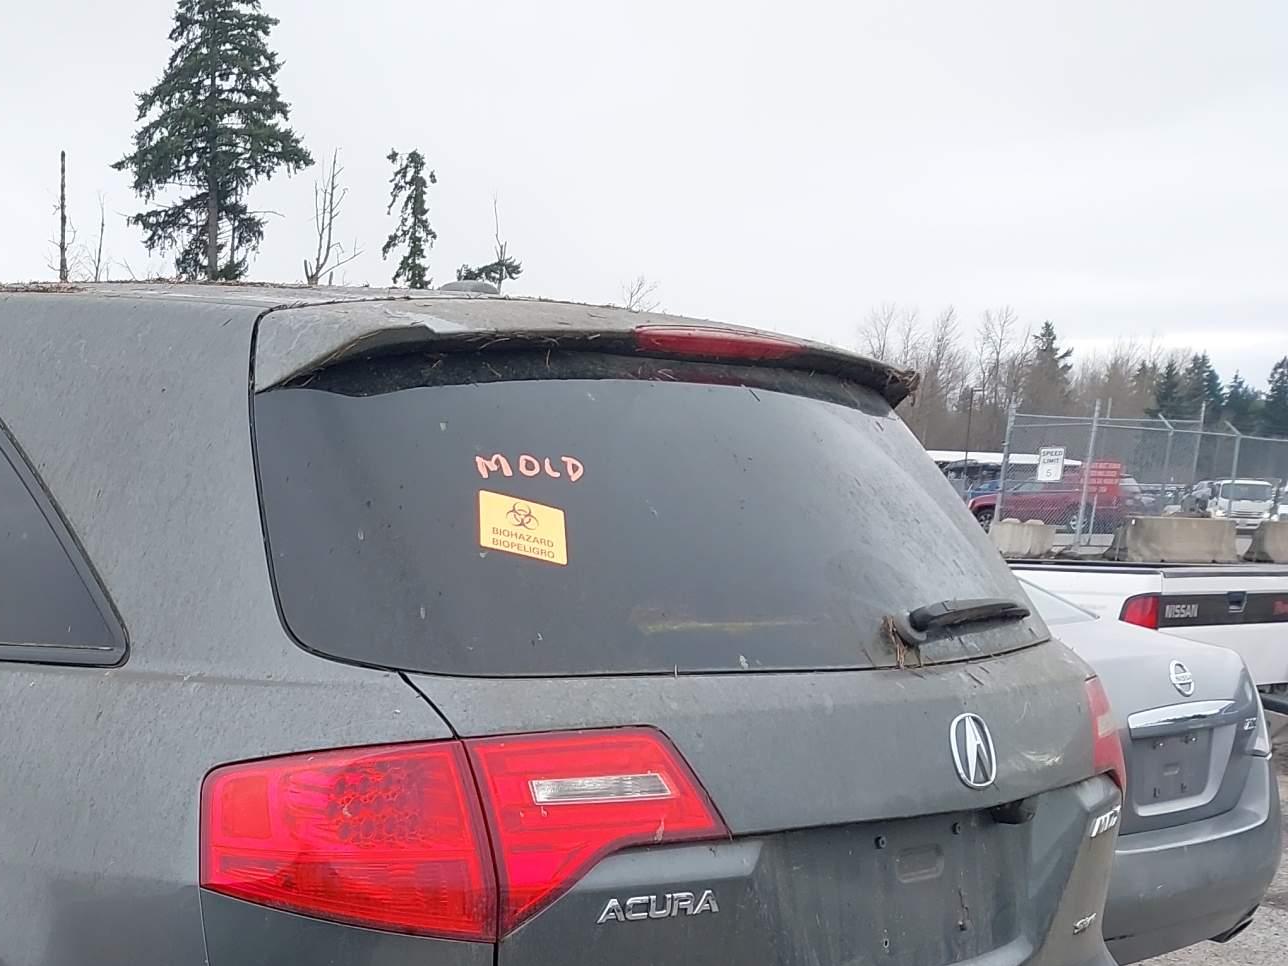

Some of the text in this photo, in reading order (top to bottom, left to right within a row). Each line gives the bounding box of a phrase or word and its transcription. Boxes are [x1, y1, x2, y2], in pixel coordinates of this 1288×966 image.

[475, 454, 584, 482] MOLD
[1046, 469, 1052, 477] 5
[492, 527, 554, 548] BIOHAZARD
[492, 537, 555, 559] BIOPELIGRO
[1165, 604, 1199, 618] NISSAN
[597, 889, 720, 924] ACURA
